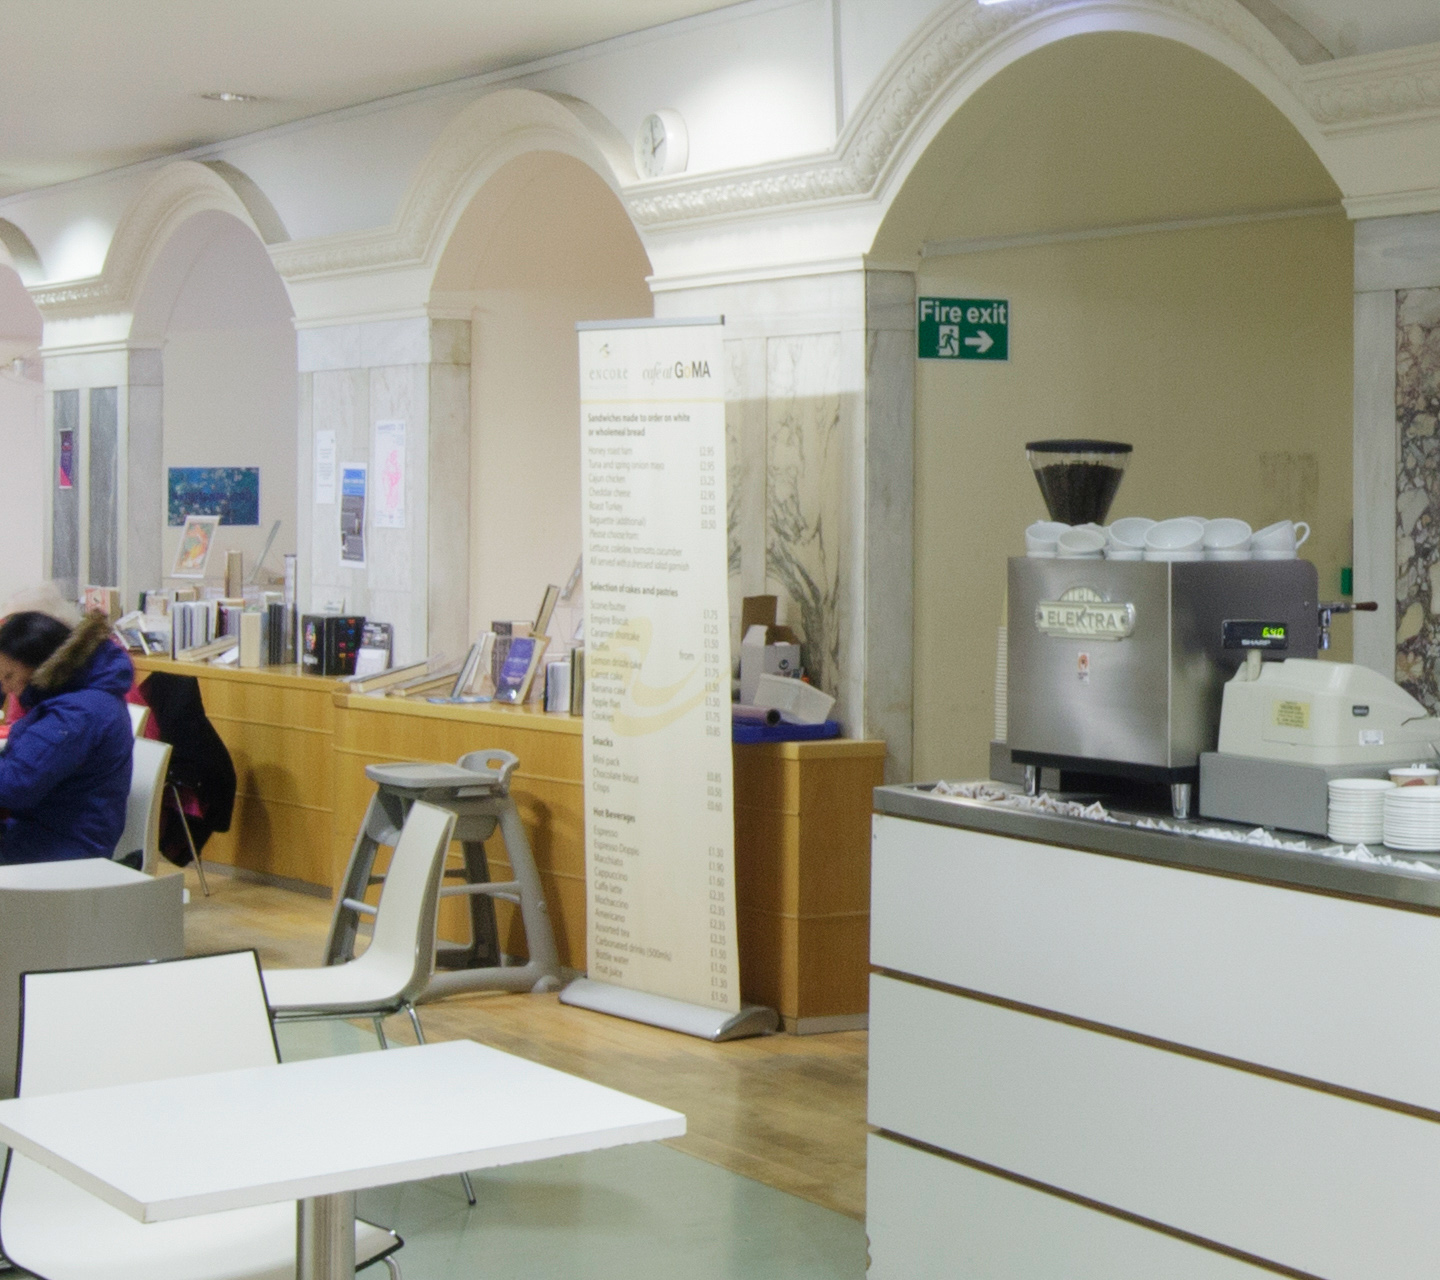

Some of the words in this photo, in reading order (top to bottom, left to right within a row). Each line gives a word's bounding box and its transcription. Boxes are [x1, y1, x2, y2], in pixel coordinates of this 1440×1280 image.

[920, 302, 962, 324] Fire
[967, 304, 1006, 325] exit
[675, 361, 711, 378] GoMA
[588, 413, 621, 422] Sandwiches
[623, 414, 638, 422] made
[648, 414, 663, 422] order
[673, 413, 690, 422] white
[596, 428, 625, 436] wholemeal
[627, 427, 645, 436] bread
[590, 582, 617, 591] Selection
[625, 585, 640, 594] cakes
[642, 587, 654, 595] and
[656, 587, 678, 597] pastries
[1048, 611, 1117, 629] ELEKTRA
[593, 736, 613, 747] Snacks
[593, 807, 603, 817] Hot
[605, 809, 635, 824] Beverages
